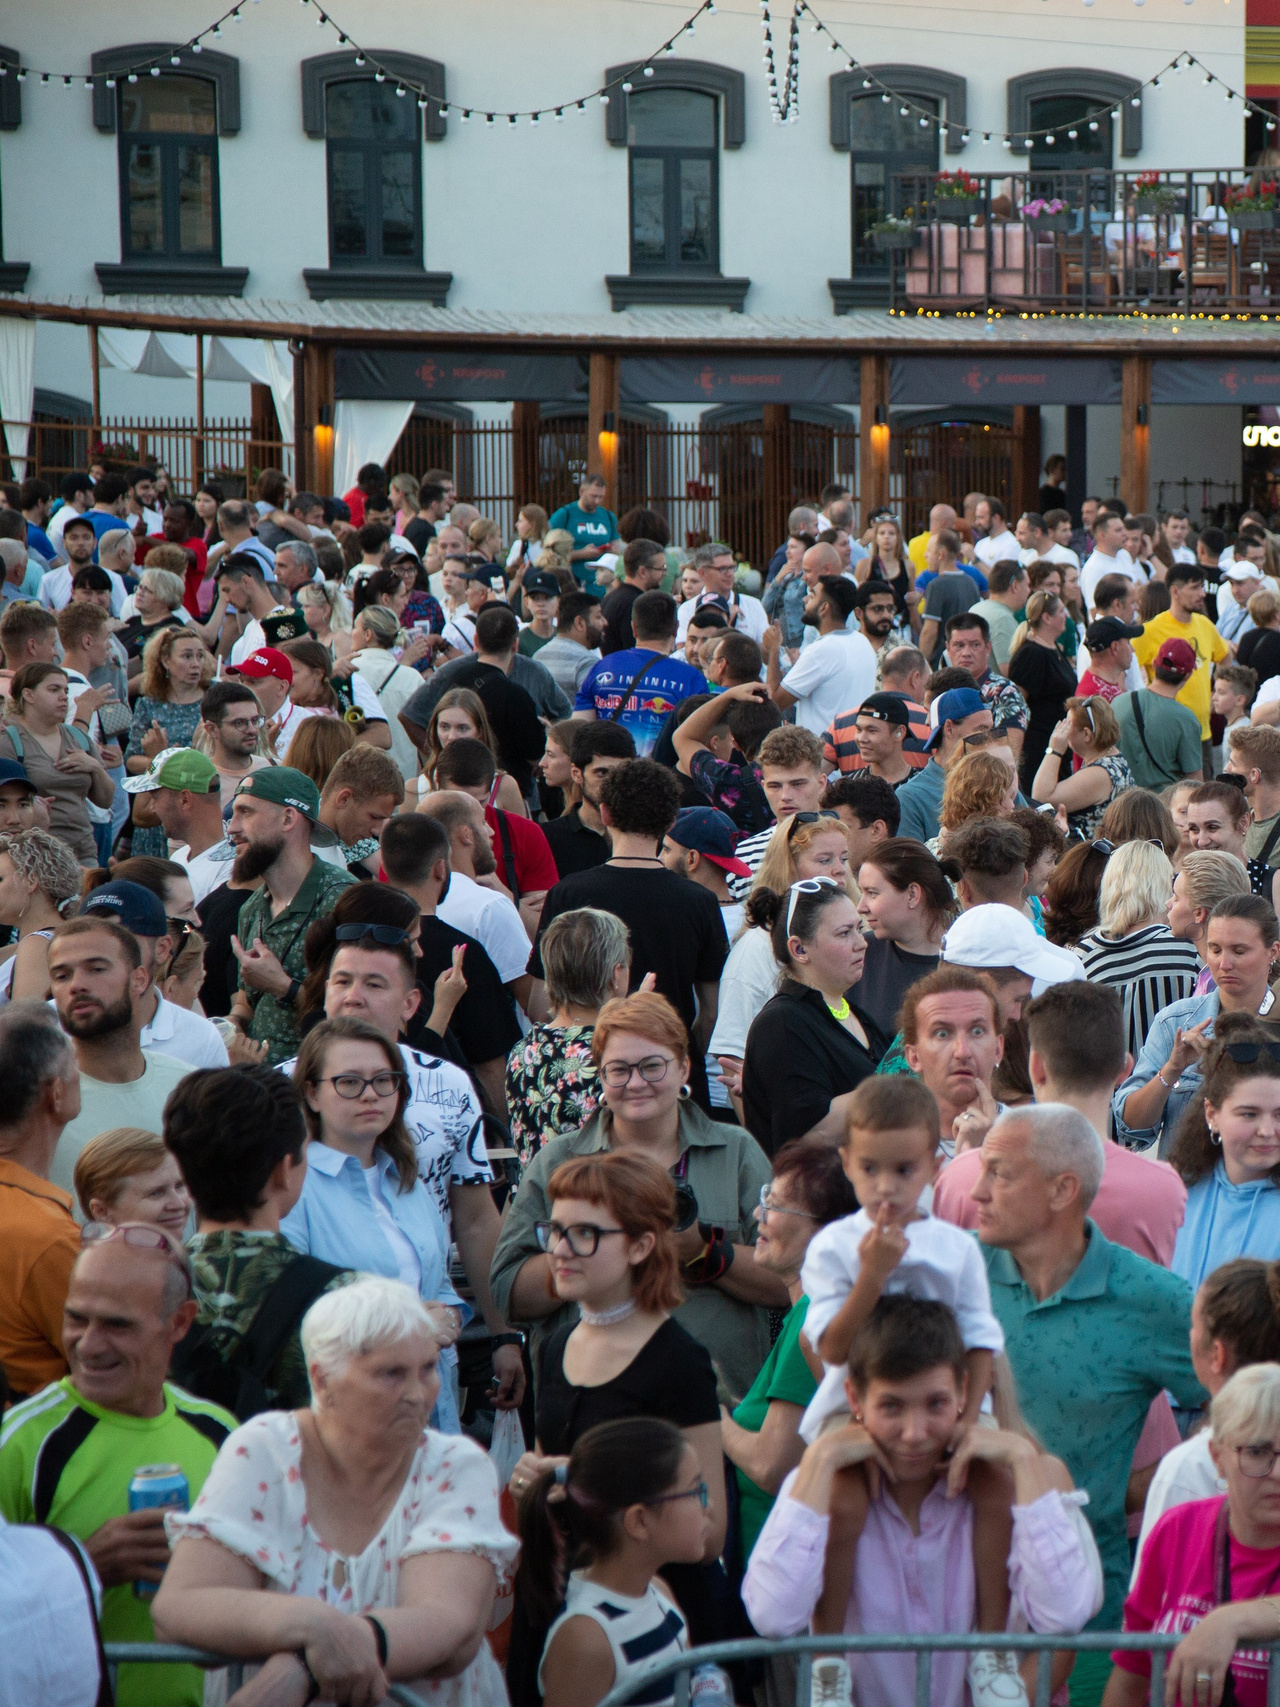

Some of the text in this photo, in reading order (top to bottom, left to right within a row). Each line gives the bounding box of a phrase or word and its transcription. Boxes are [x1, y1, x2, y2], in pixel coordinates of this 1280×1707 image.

[577, 522, 608, 535] FILA
[618, 674, 684, 692] ININITI
[284, 798, 310, 811] JETS
[86, 897, 123, 907] LIGHTNING
